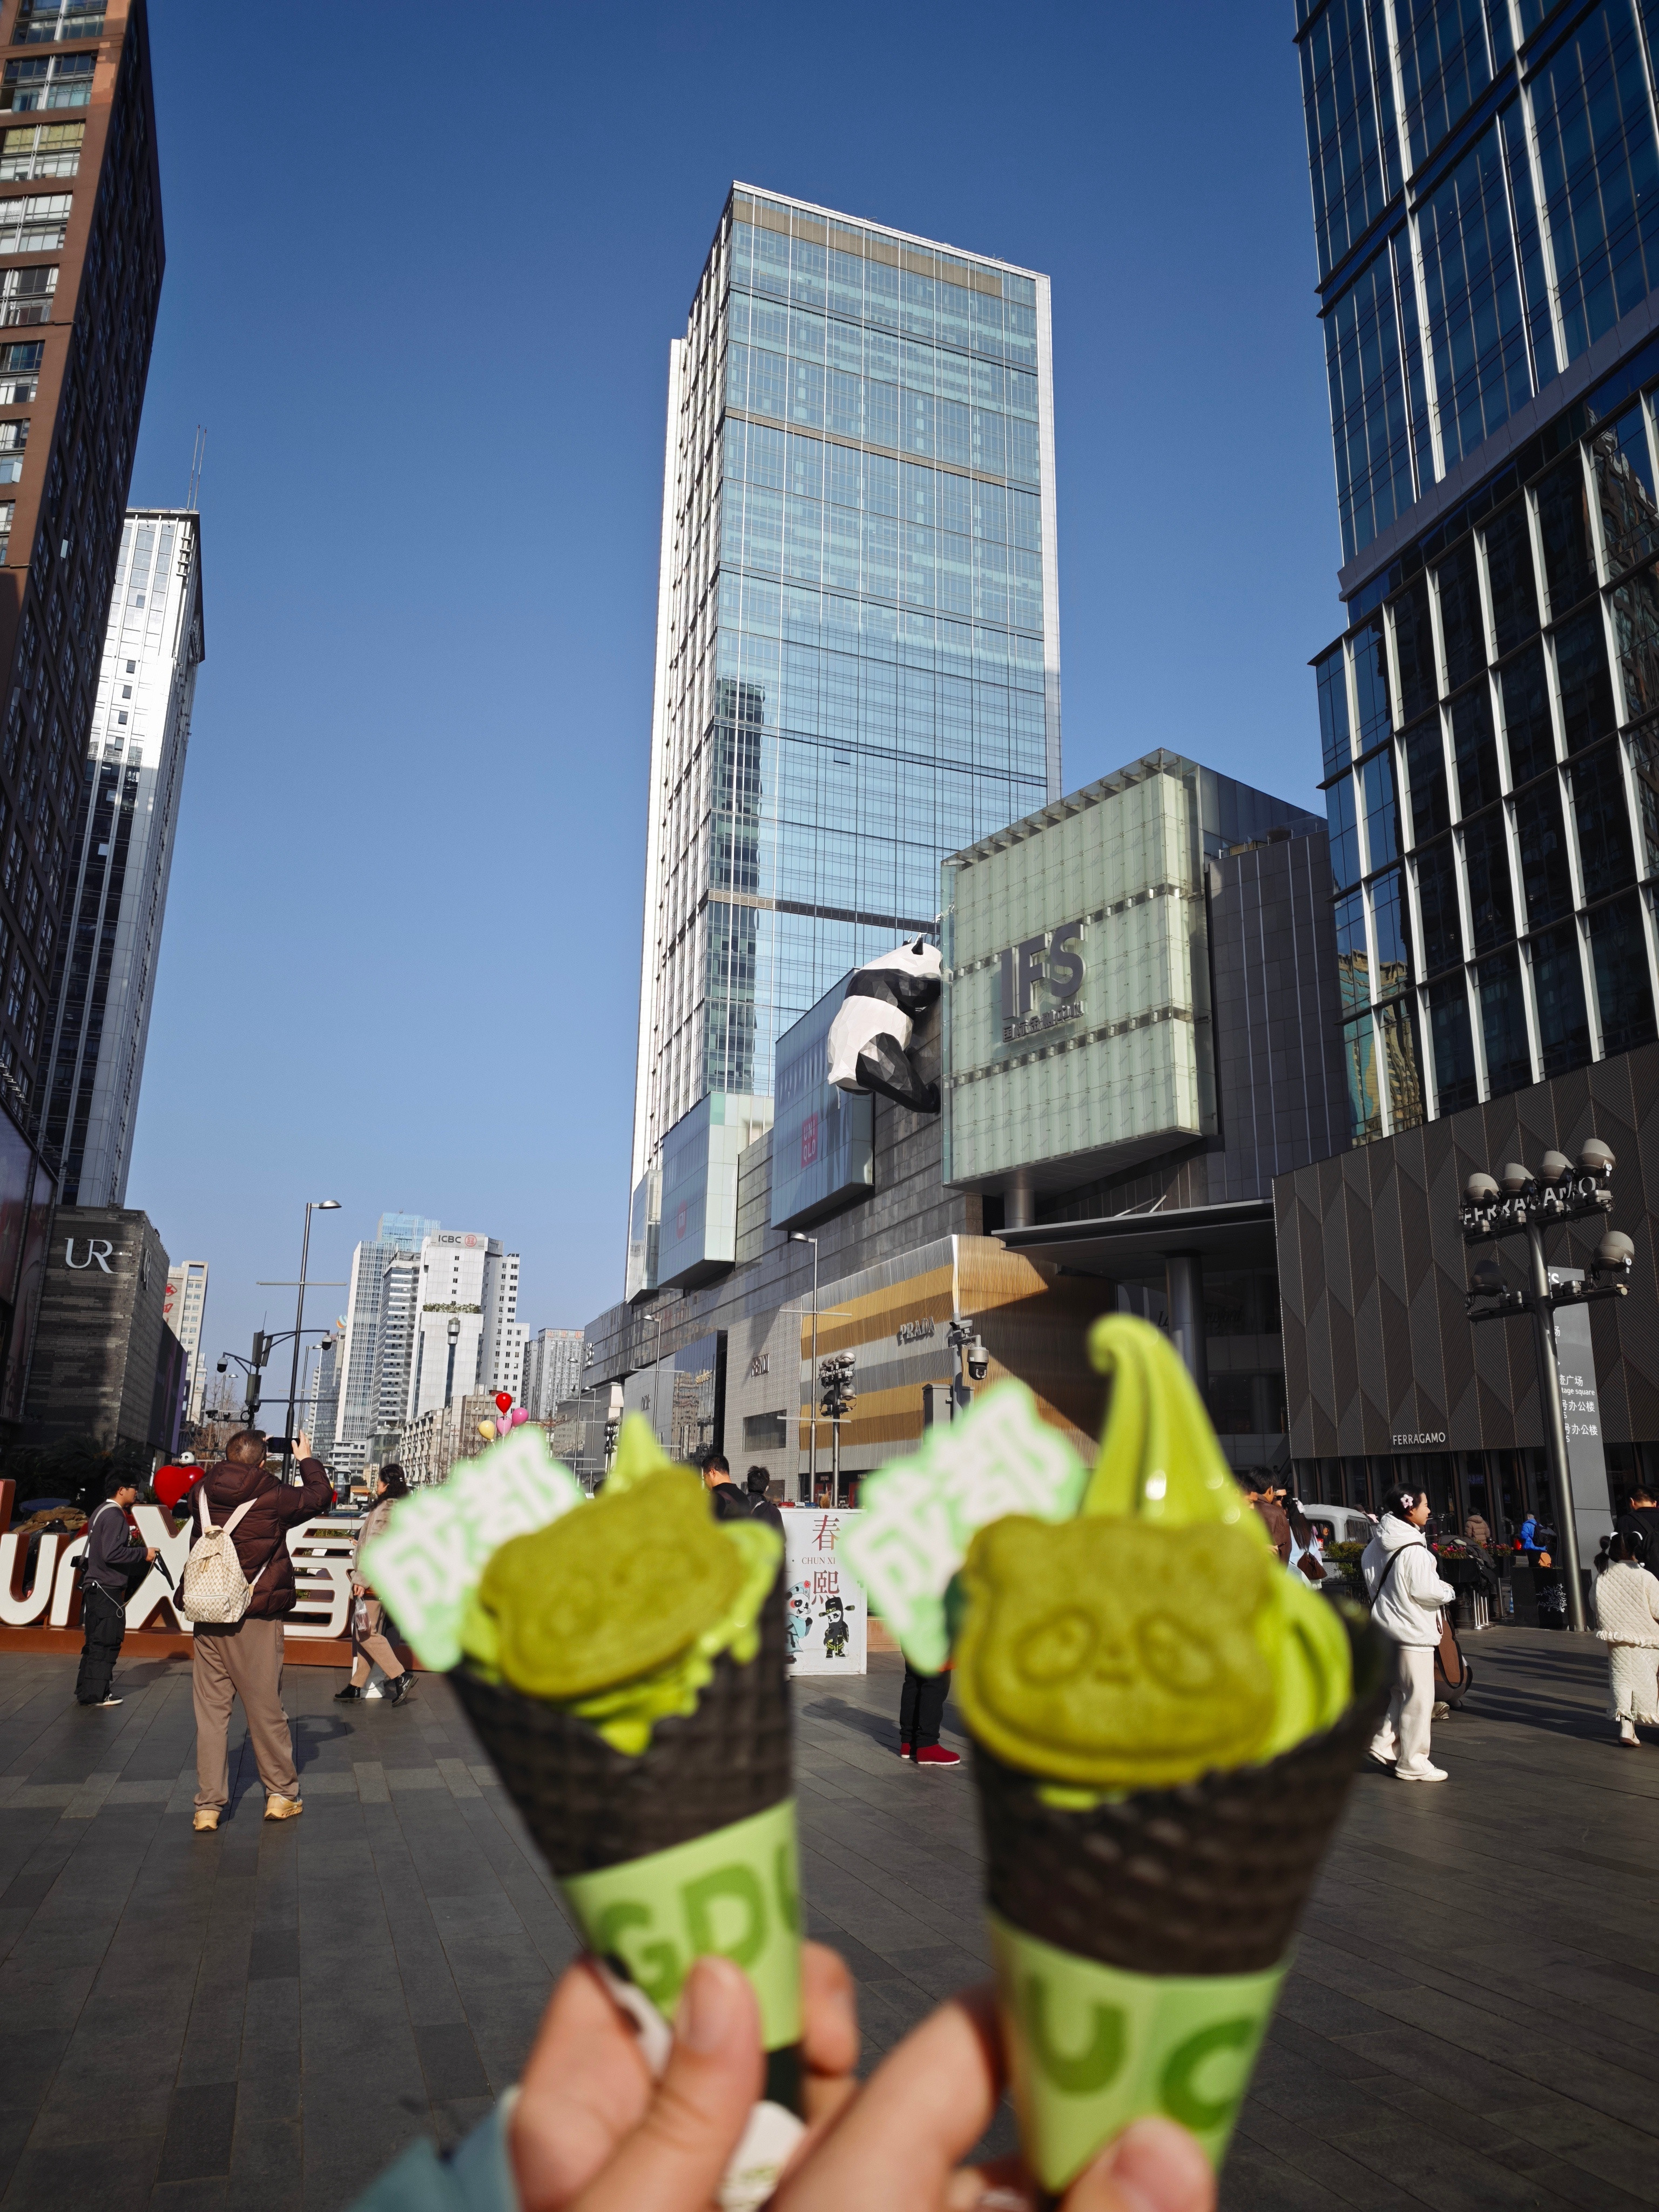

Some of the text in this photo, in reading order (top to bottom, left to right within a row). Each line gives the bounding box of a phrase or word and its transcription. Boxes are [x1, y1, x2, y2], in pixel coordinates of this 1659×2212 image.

[1001, 922, 1086, 1020] IFS
[1002, 1001, 1084, 1043] 国际金融中心
[804, 1120, 815, 1141] UNI
[803, 1139, 815, 1162] QLO
[438, 1235, 462, 1244] ICBC
[64, 1237, 118, 1274] UR
[900, 1316, 937, 1340] PRADA
[1393, 1432, 1446, 1445] FERRAGAMO
[811, 1514, 841, 1551] 春
[811, 1569, 840, 1606] 熙
